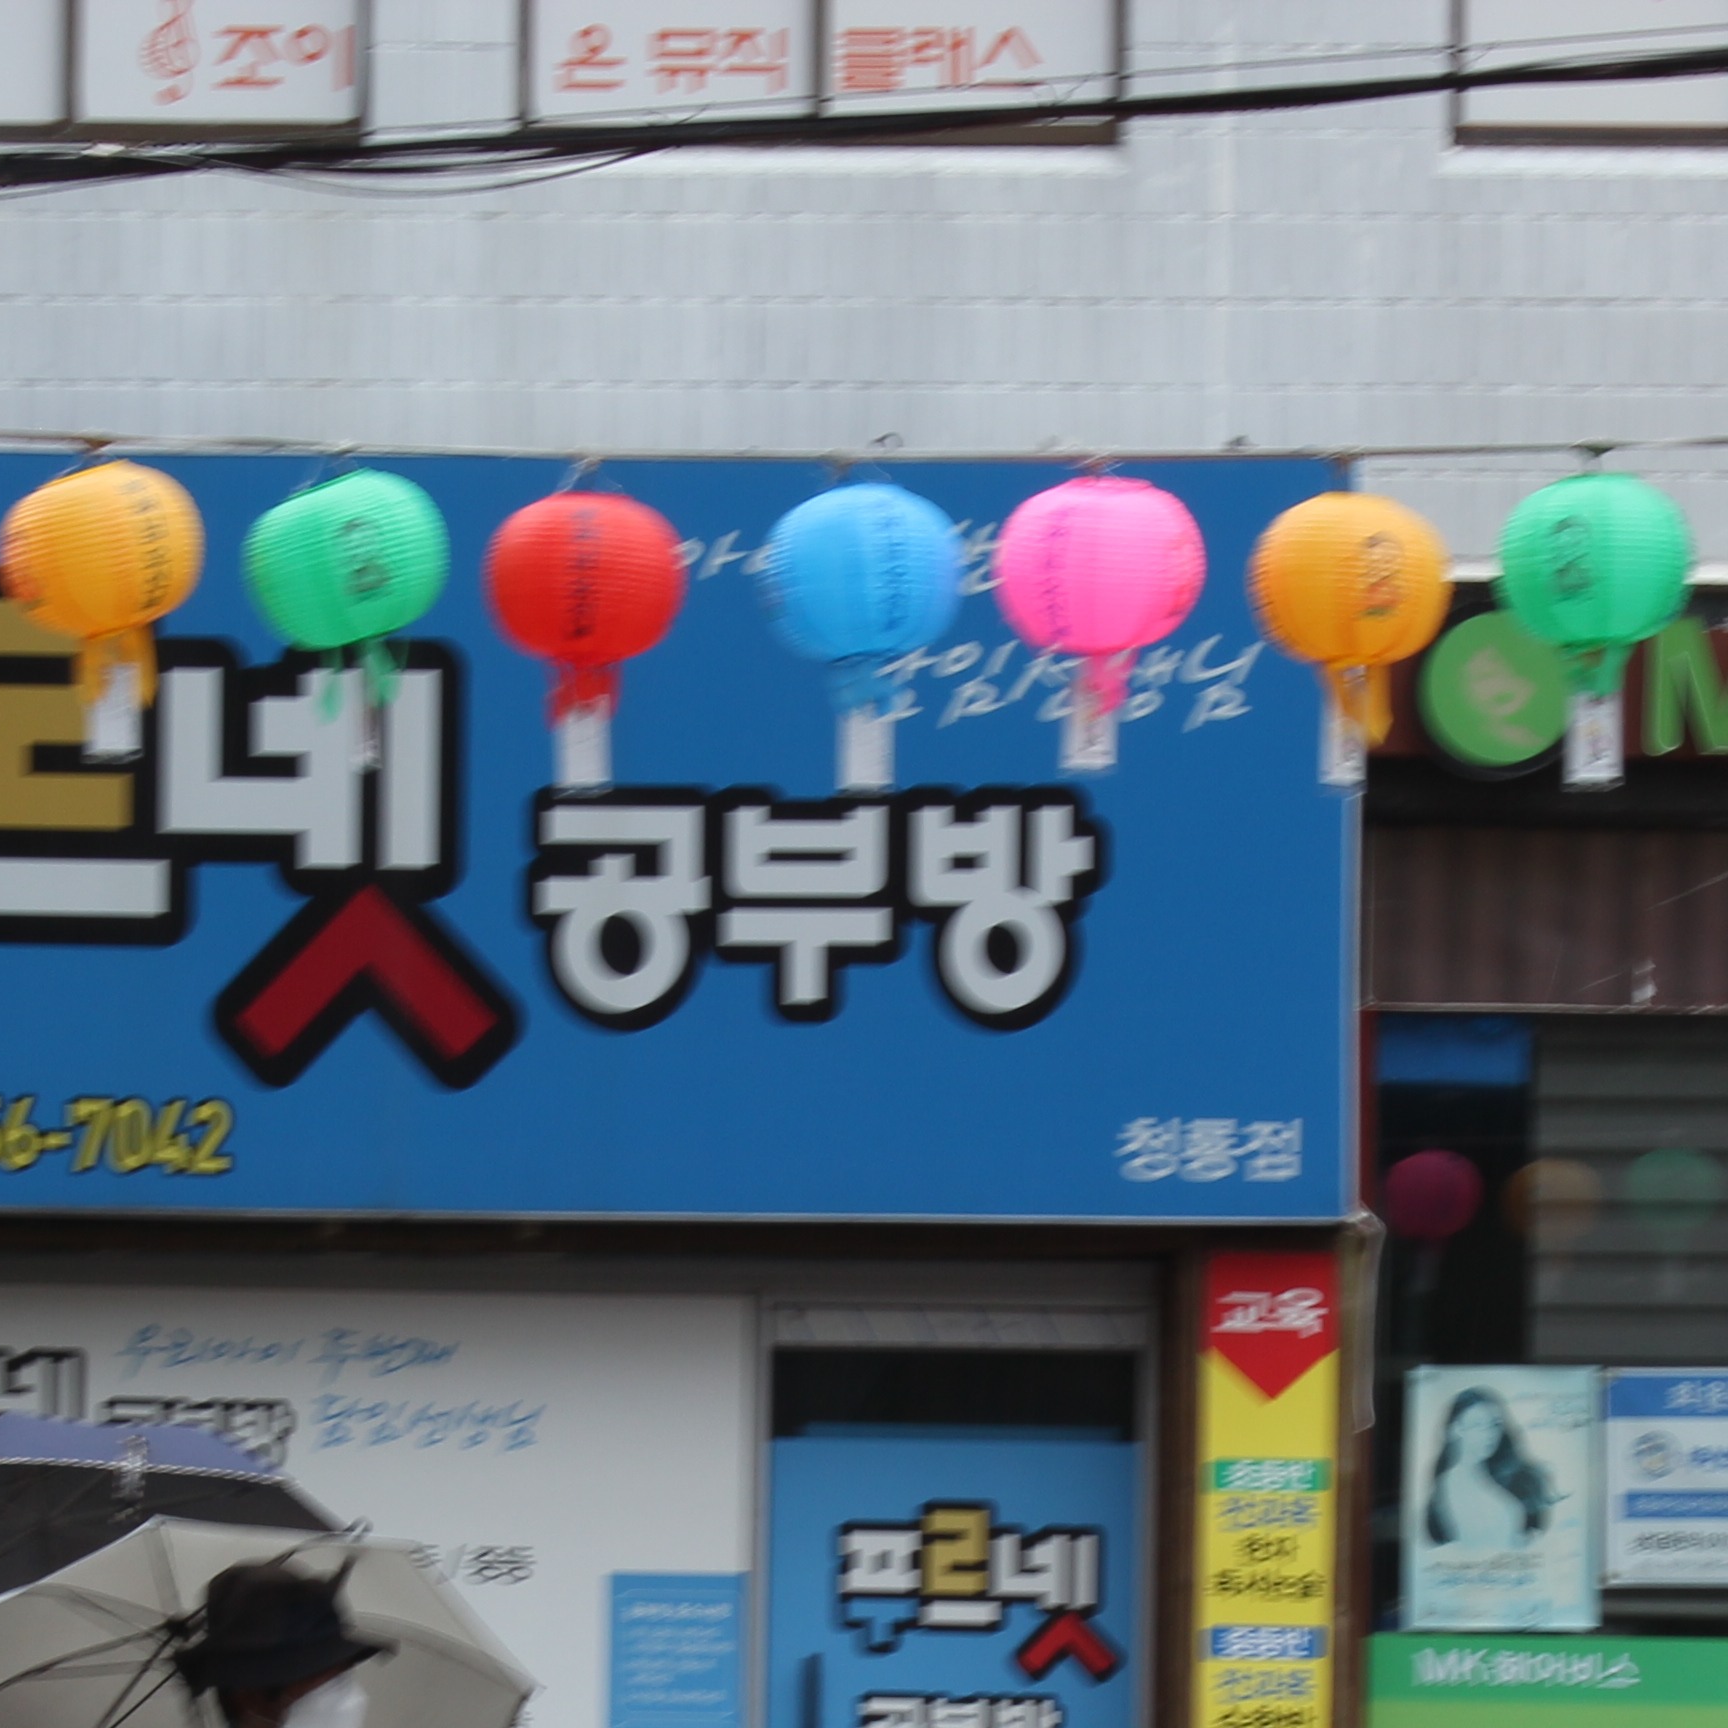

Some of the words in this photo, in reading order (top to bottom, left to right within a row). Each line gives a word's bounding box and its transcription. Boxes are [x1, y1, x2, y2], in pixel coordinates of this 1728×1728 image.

[210, 24, 356, 92] 조이
[552, 23, 628, 94] 온
[642, 26, 793, 95] 뮤직
[832, 24, 1046, 94] 클래스
[528, 786, 1110, 1034] 공부방
[1113, 1116, 1304, 1183] 청룡점
[1211, 1287, 1329, 1340] 교육
[834, 1500, 1126, 1682] 푸르넷
